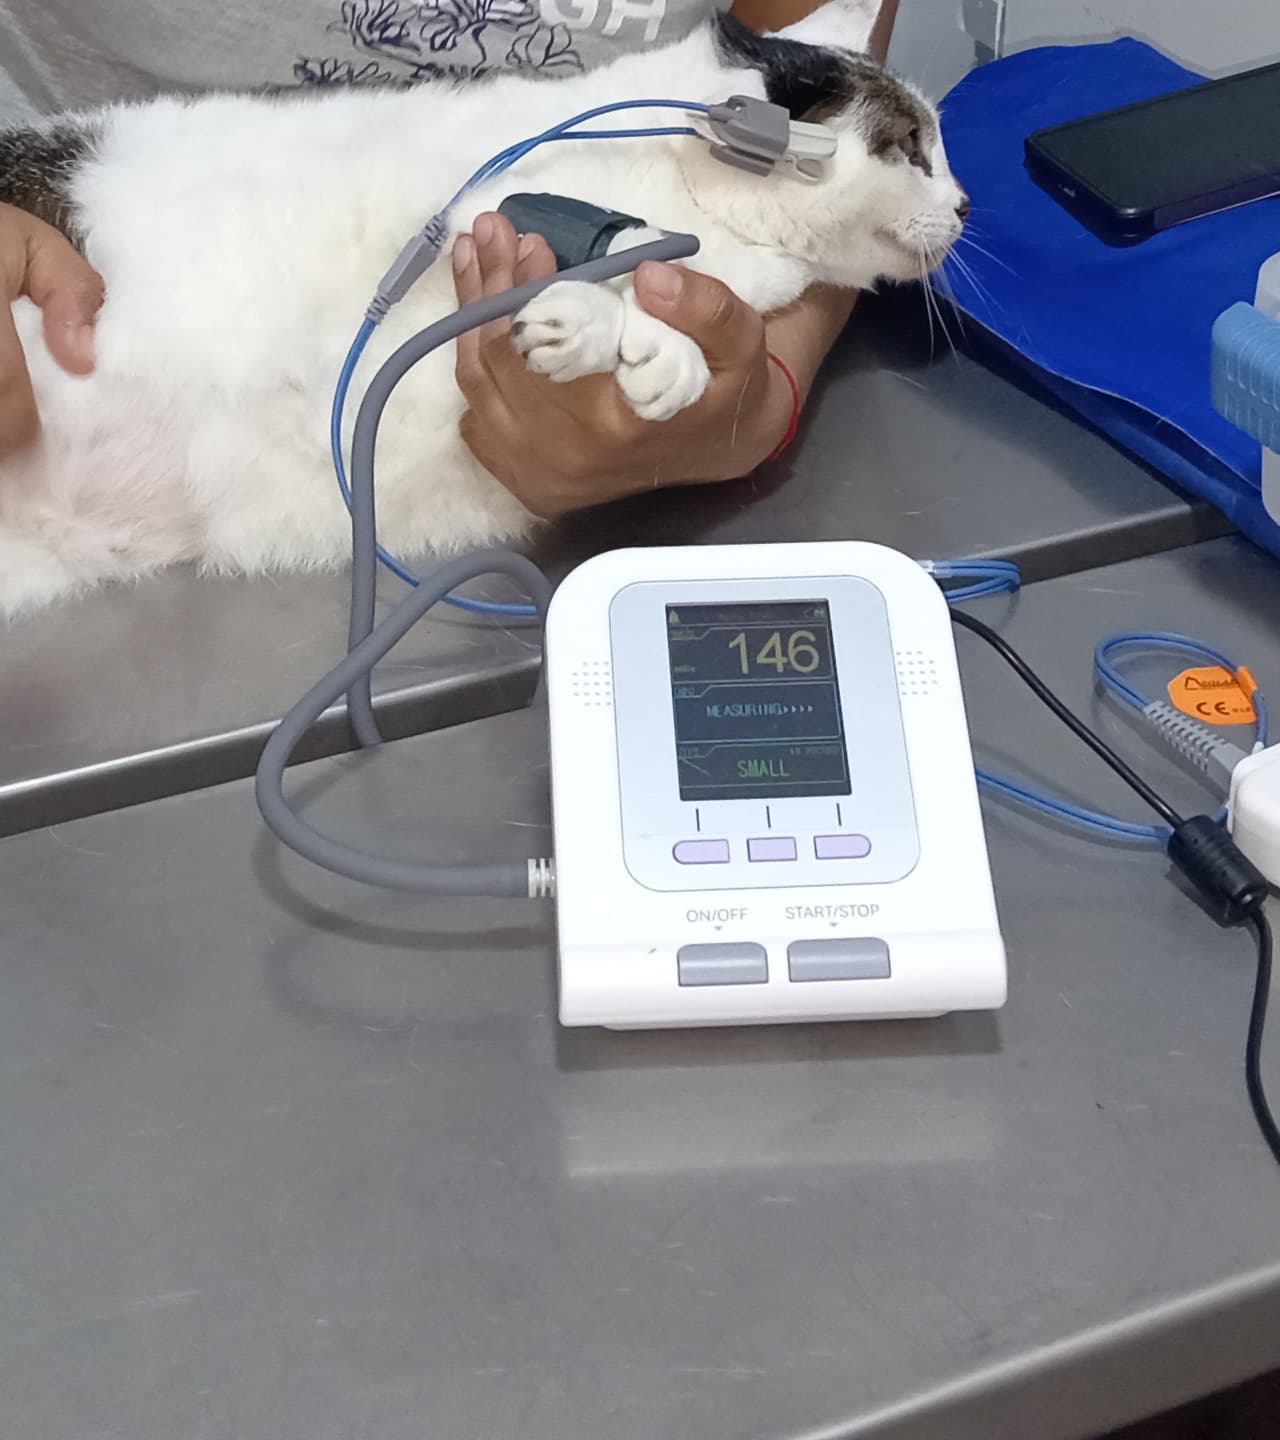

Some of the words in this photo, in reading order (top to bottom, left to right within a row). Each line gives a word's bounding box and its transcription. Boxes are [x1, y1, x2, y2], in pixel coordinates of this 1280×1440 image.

[728, 629, 820, 675] 146
[736, 759, 790, 778] SMALL
[685, 907, 749, 923] ON/OFF
[784, 903, 881, 920] START/STOP
